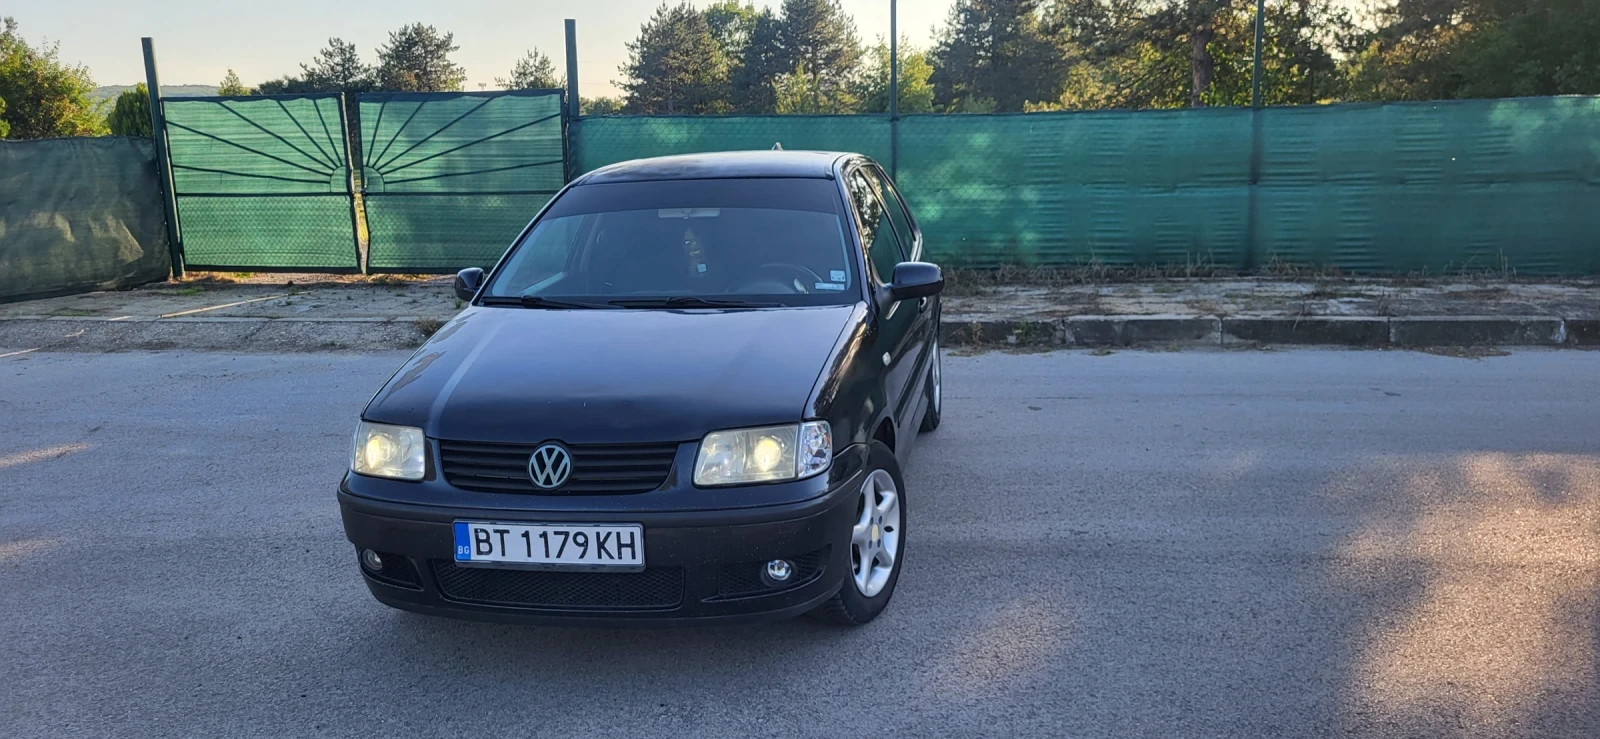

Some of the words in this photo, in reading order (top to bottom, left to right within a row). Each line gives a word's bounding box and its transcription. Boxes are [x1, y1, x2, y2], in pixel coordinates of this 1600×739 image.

[529, 445, 570, 488] VW
[457, 545, 470, 555] BG
[474, 528, 511, 557] BT
[520, 530, 589, 560] 1179
[595, 531, 636, 560] KH
